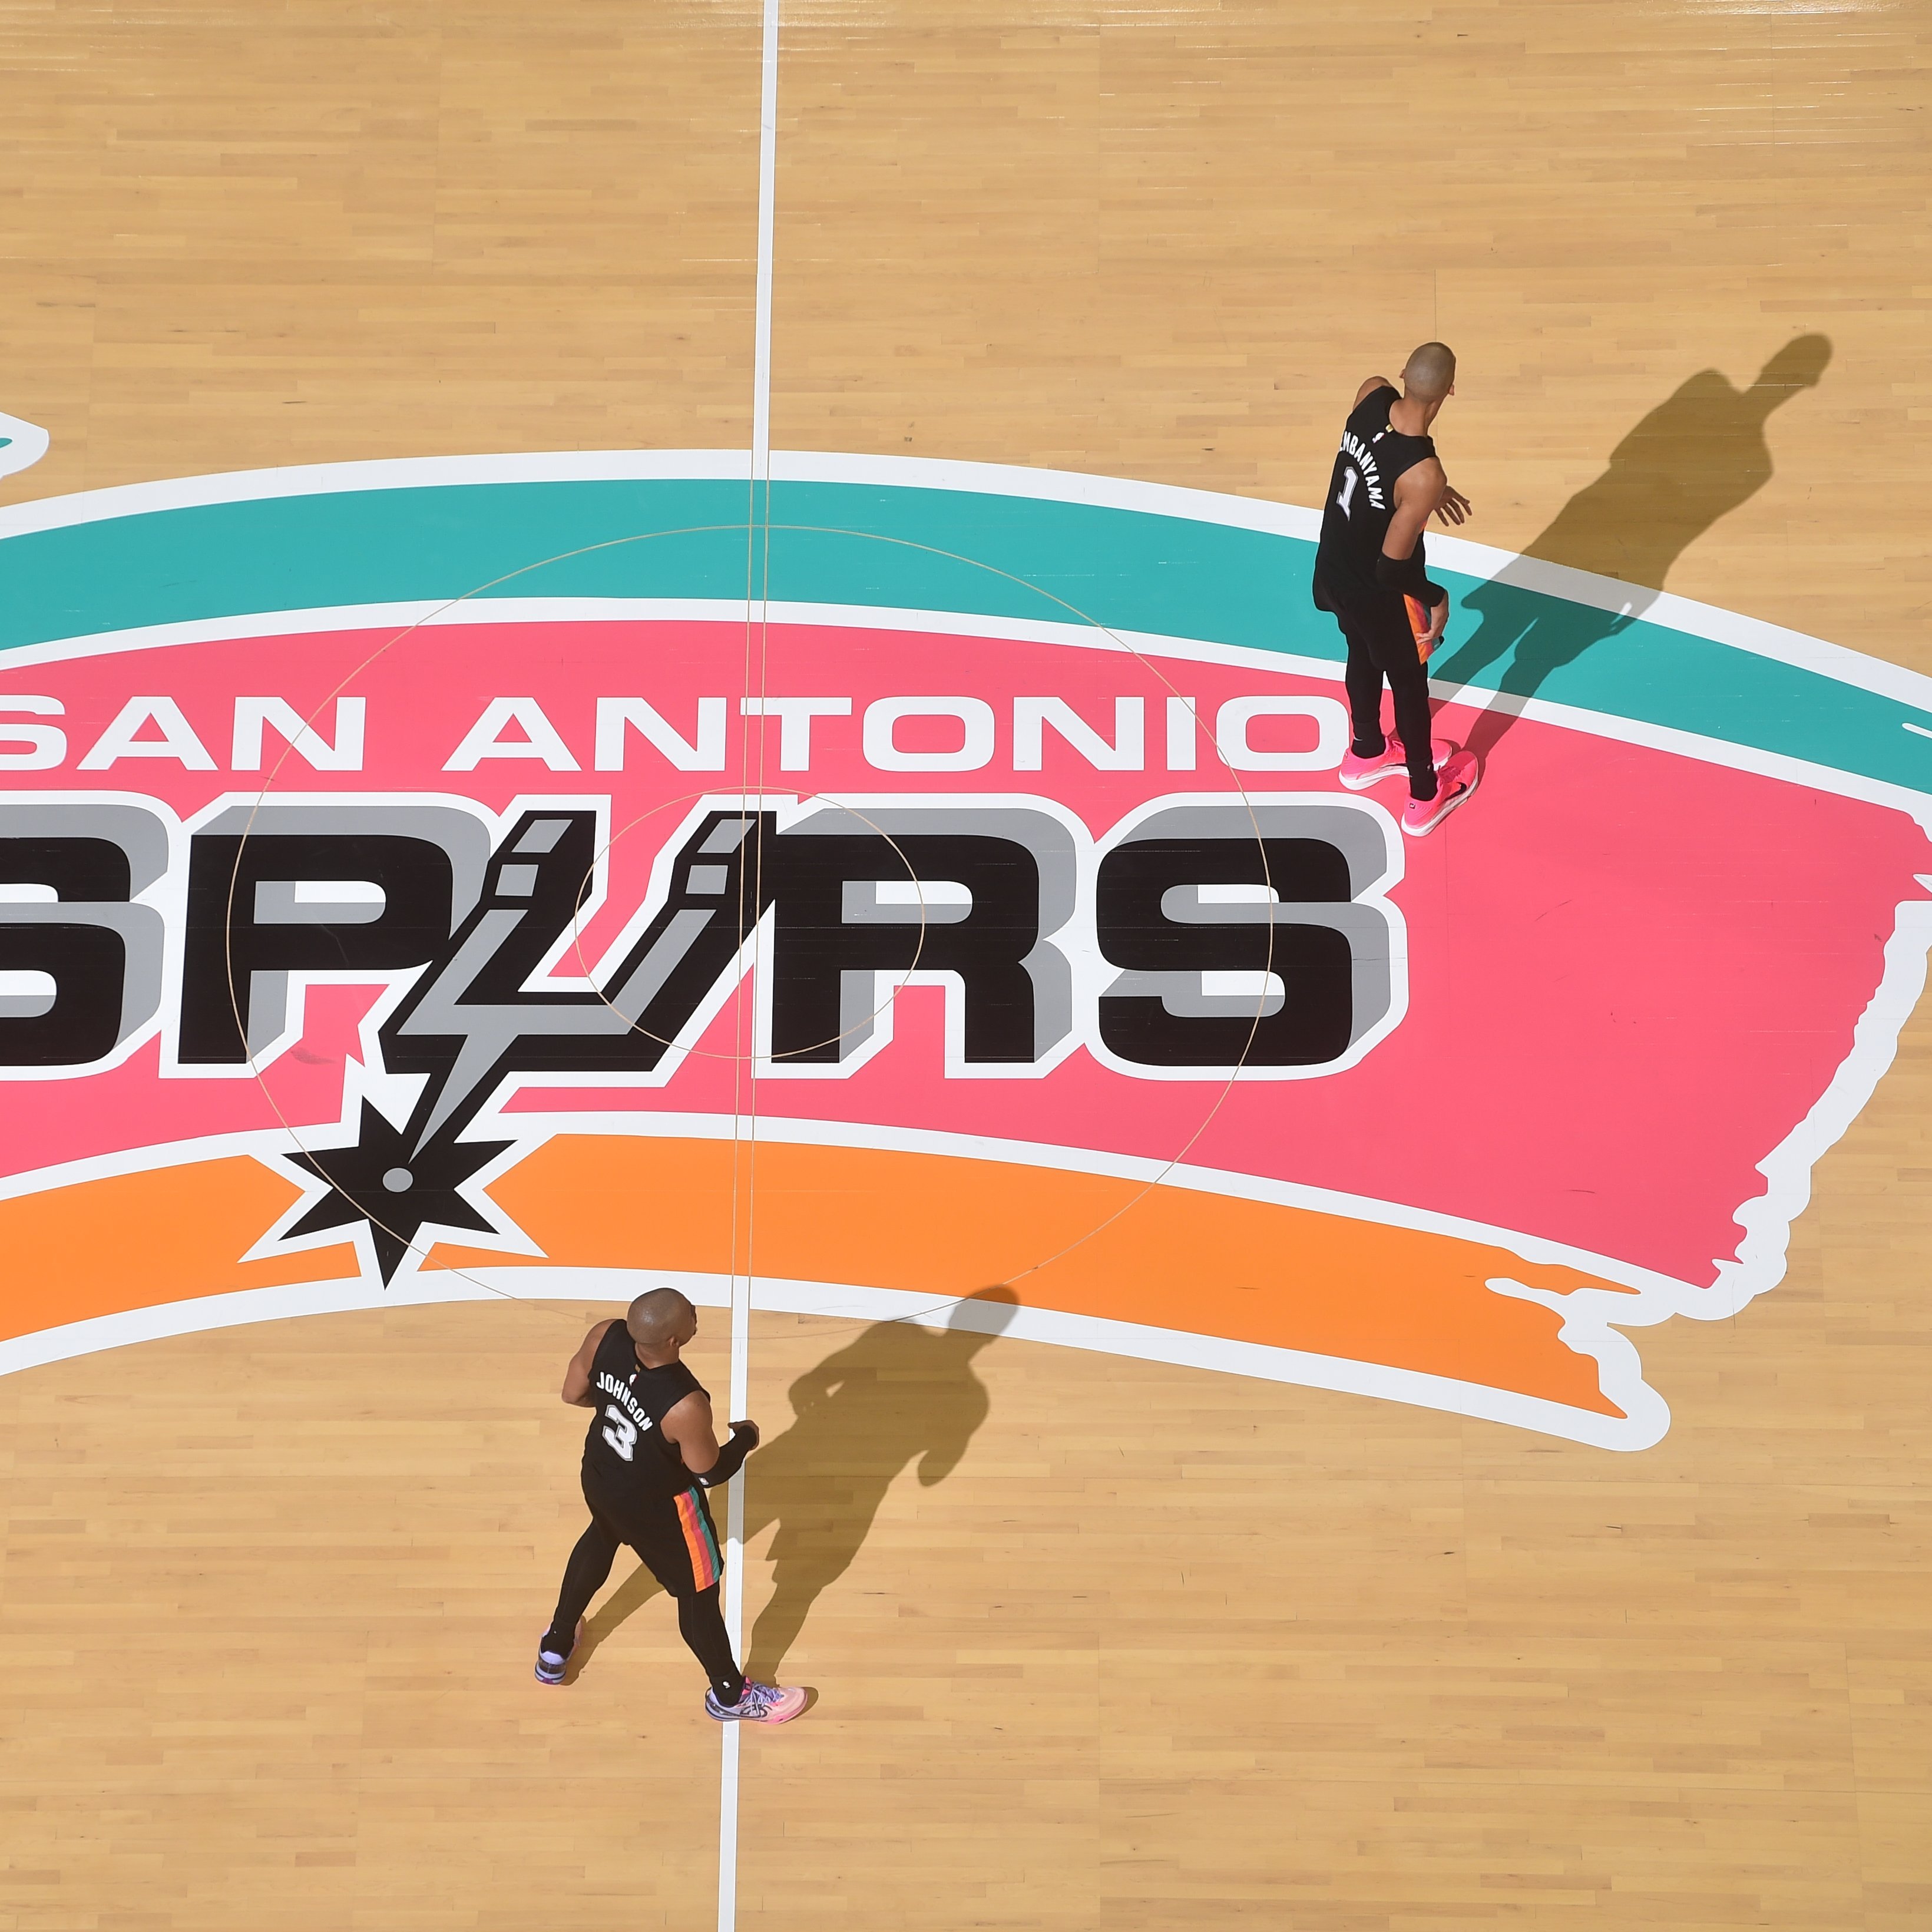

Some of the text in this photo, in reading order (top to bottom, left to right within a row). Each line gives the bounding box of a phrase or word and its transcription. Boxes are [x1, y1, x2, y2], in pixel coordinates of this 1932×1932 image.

[1336, 466, 1359, 522] 1
[1339, 431, 1386, 510] MBANYAMA
[441, 695, 1349, 773] ANTONIO
[596, 1371, 653, 1432] JOHNSON
[602, 1404, 638, 1462] 3
